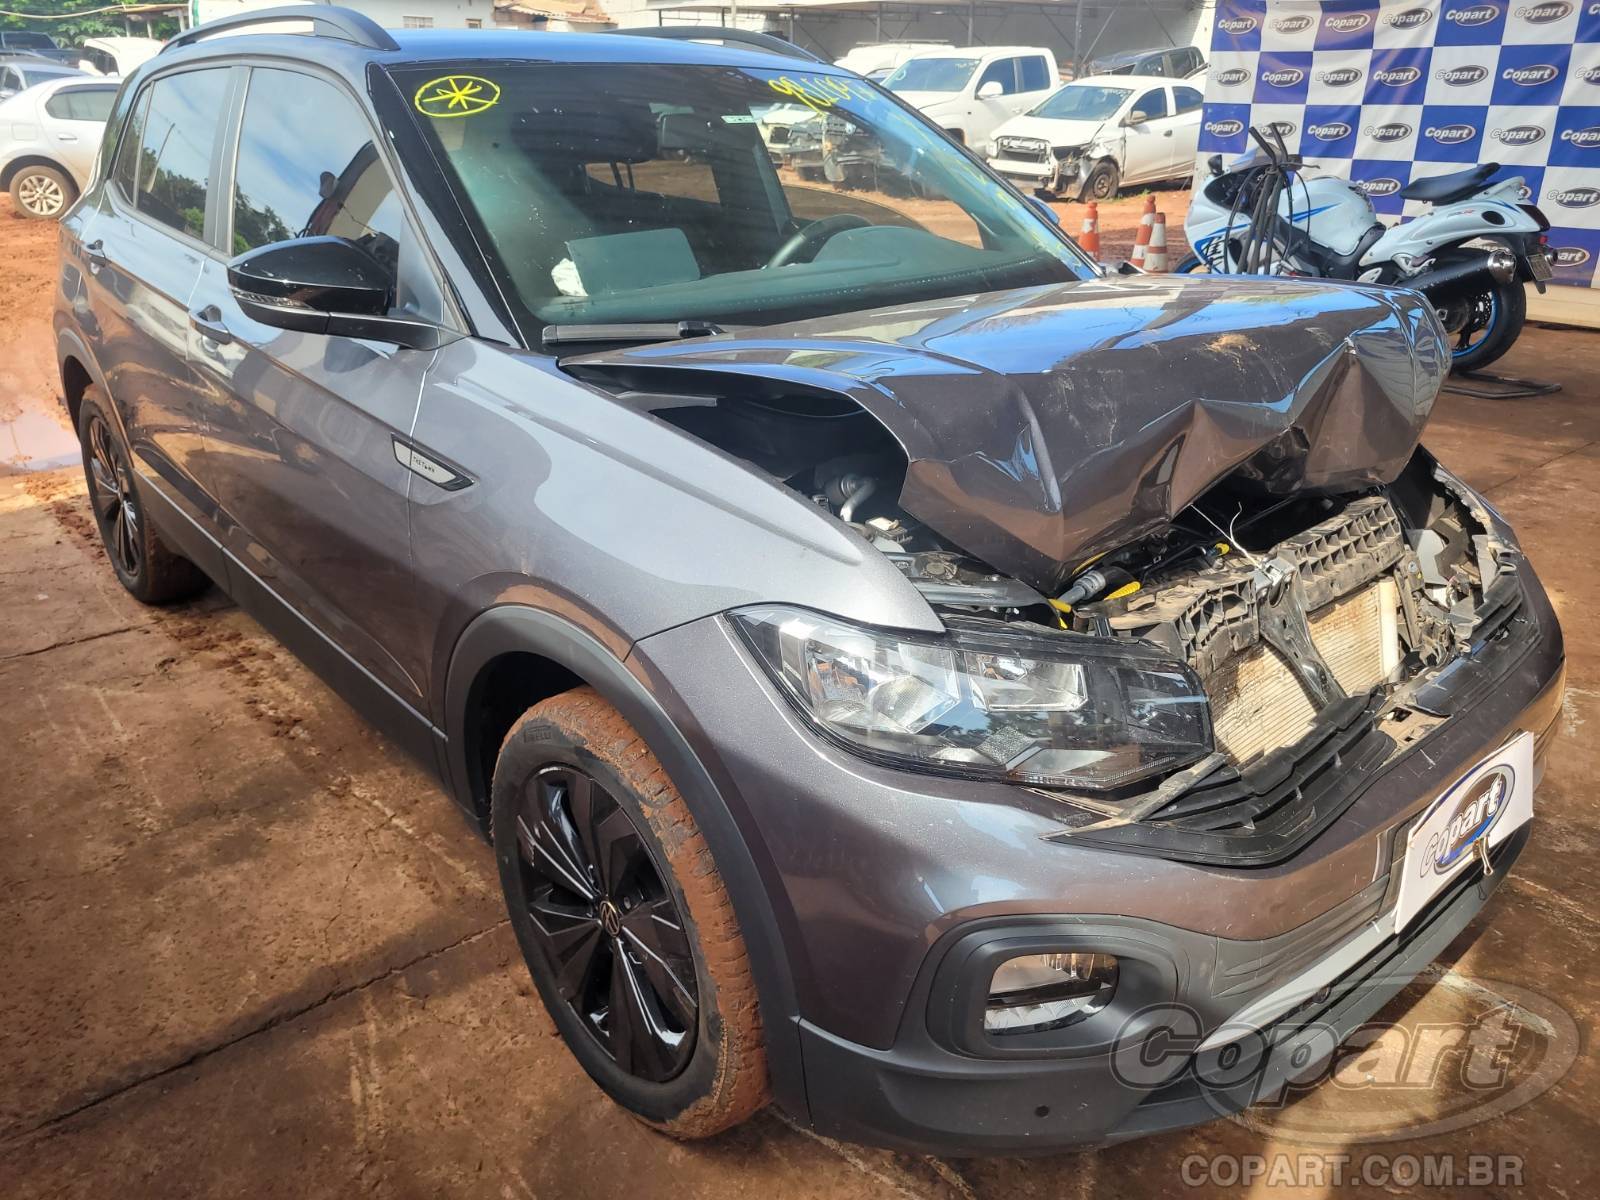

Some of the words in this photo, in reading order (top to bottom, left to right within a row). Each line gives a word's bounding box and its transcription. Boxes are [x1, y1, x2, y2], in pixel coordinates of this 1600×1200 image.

[1383, 11, 1427, 26] Copart
[1446, 7, 1492, 23] Copart
[1514, 4, 1565, 20] Copart
[1218, 17, 1252, 31] Copart
[1325, 15, 1365, 29] Copart
[1262, 69, 1298, 83] Copart
[1316, 69, 1355, 83] Copart
[1373, 68, 1417, 82] Copart
[1435, 67, 1483, 83] Copart
[1502, 67, 1552, 83] Copart
[1205, 121, 1240, 135] Copart
[1307, 123, 1346, 137] Copart
[1364, 123, 1405, 137] Copart
[1425, 125, 1471, 140] Copart
[1490, 126, 1541, 141] Copart
[1560, 129, 1600, 143] Copa
[1547, 189, 1598, 203] Copart
[1420, 773, 1503, 879] Copart
